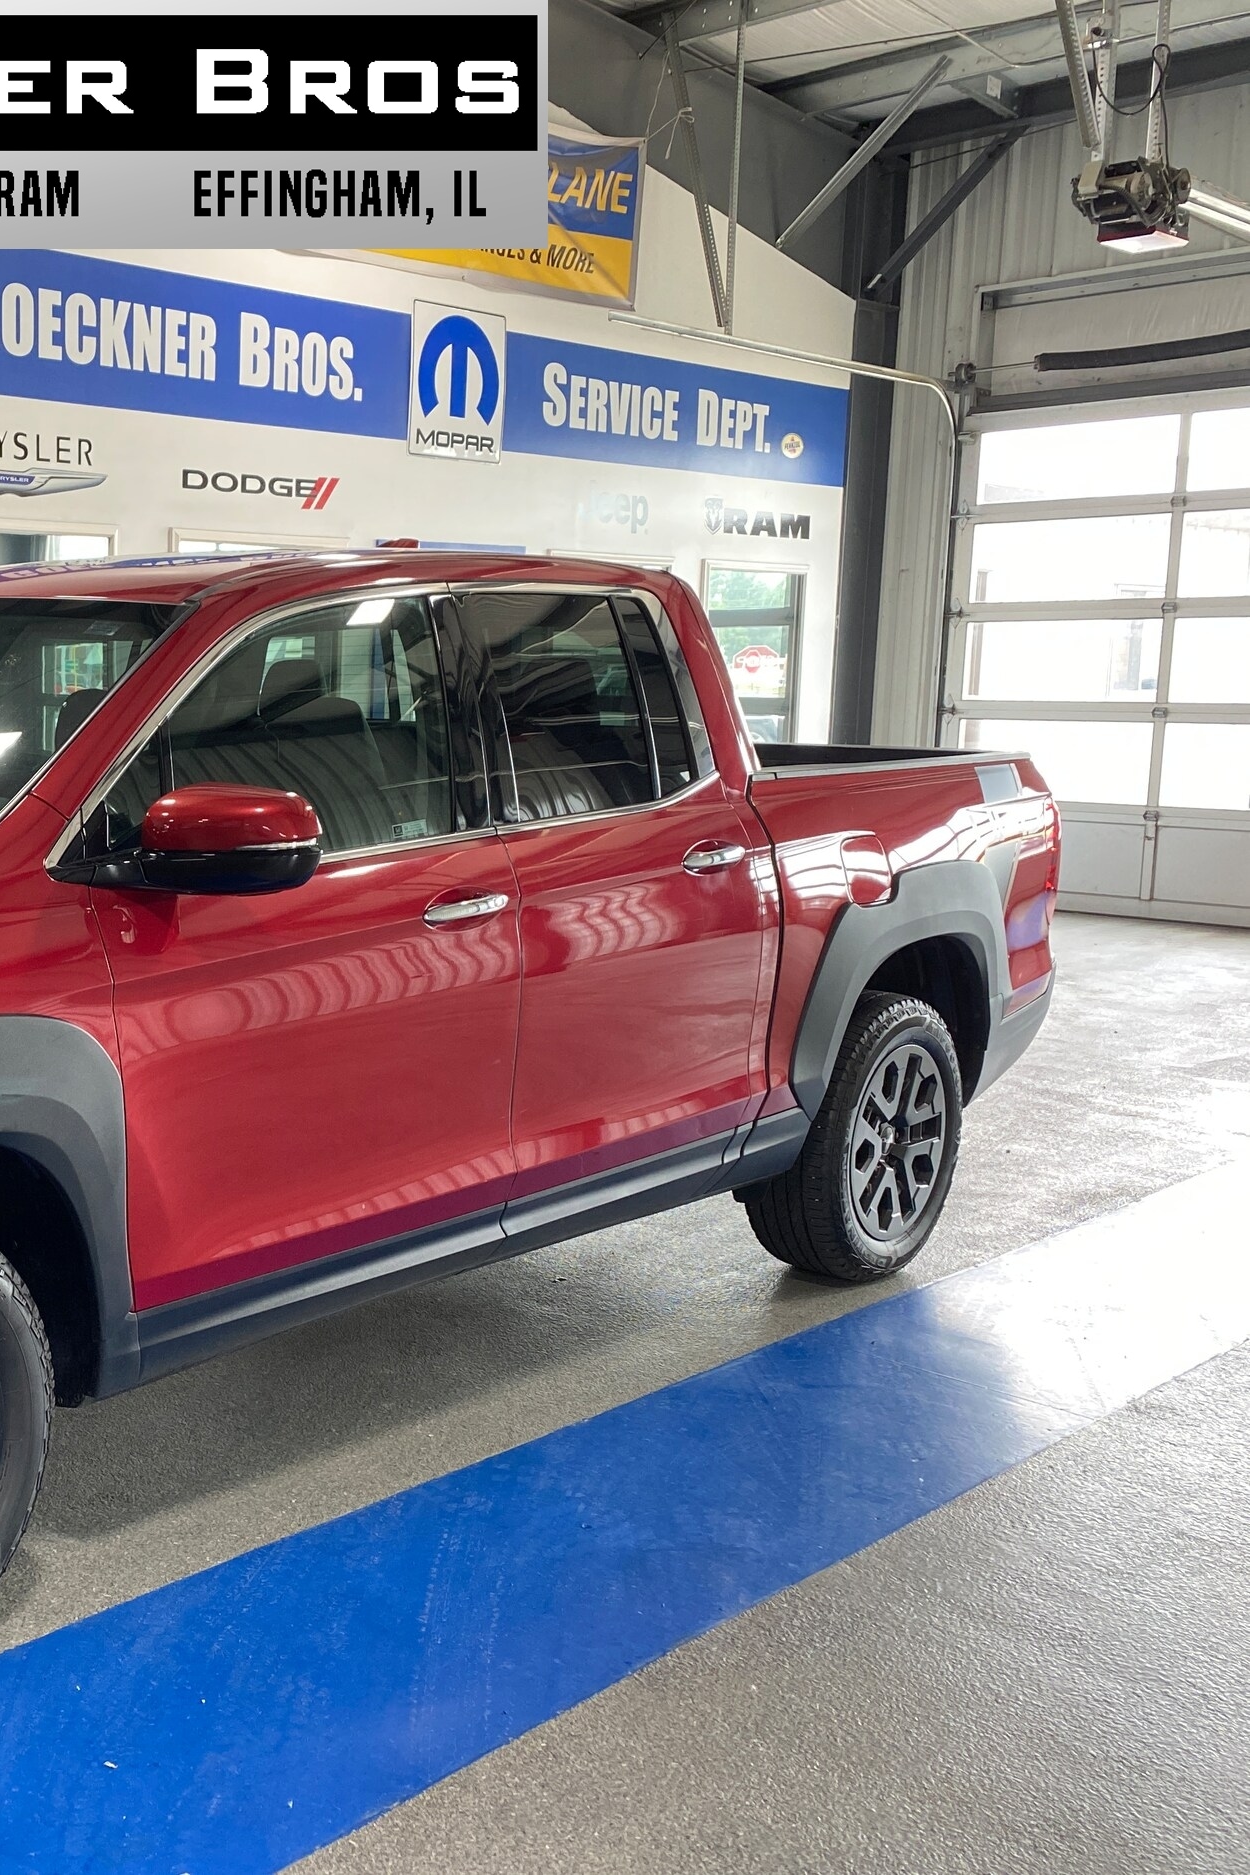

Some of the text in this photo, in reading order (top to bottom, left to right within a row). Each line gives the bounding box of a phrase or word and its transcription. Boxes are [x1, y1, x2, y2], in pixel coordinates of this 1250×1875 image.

[548, 161, 634, 214] LANE
[547, 244, 595, 274] MORE
[238, 312, 363, 403] BROS.
[542, 362, 771, 454] SERVICE DEPT.
[416, 428, 494, 453] MOPAR
[181, 468, 319, 498] DODGE
[723, 507, 810, 539] RAM
